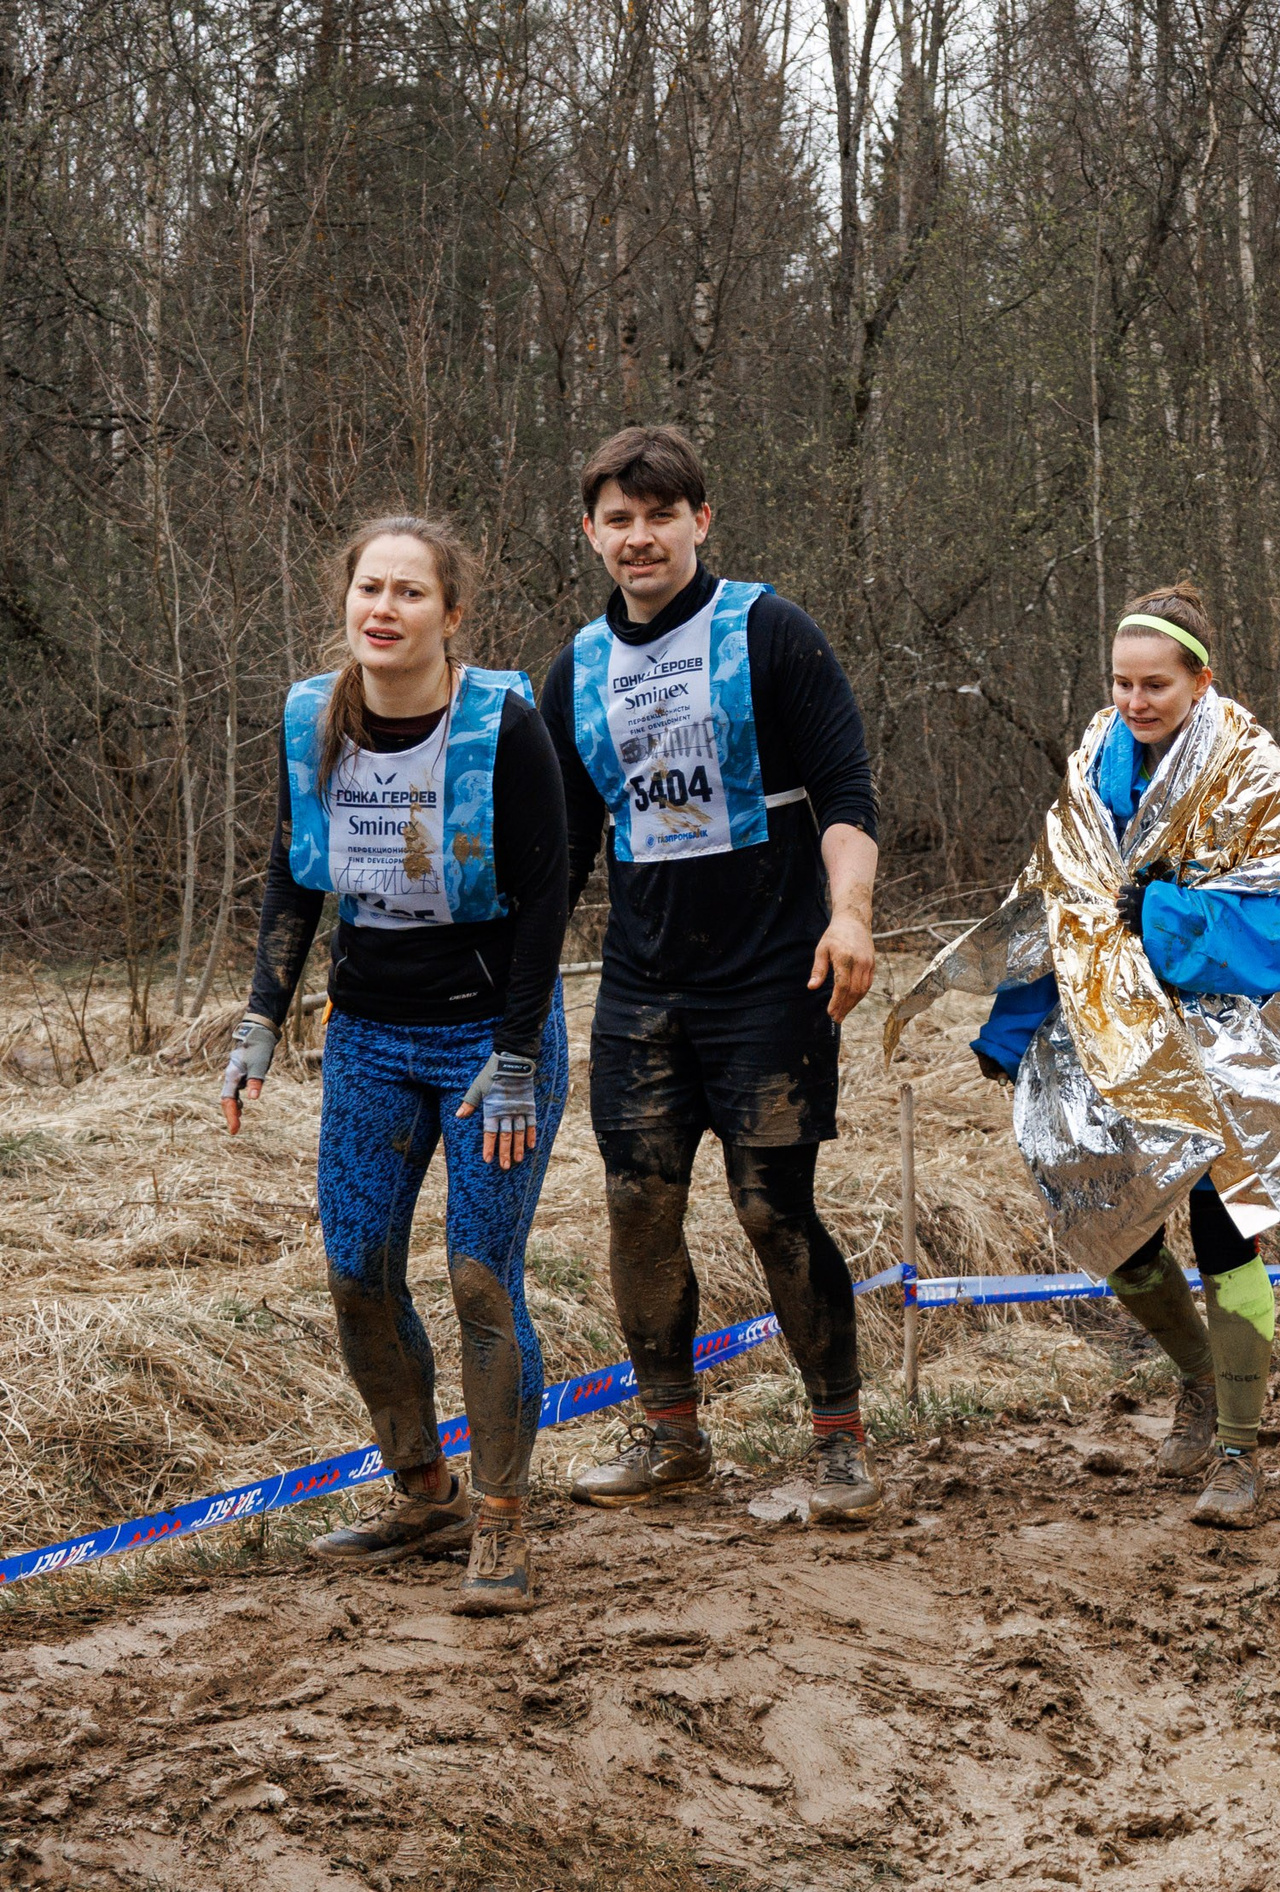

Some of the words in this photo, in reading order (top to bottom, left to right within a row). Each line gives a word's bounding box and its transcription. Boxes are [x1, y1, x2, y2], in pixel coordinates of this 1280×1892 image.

[654, 657, 703, 675] ГЕРОЕВ
[625, 683, 689, 710] Sminex
[629, 725, 646, 736] FINE
[647, 714, 691, 731] DEVELOPMENT
[336, 789, 380, 804] ГОНКА
[382, 791, 437, 804] ГЕРОЕВ
[629, 765, 713, 812] 5404
[348, 815, 420, 836] Sminex
[349, 856, 364, 864] FINE
[367, 857, 405, 865] DEVELOPM
